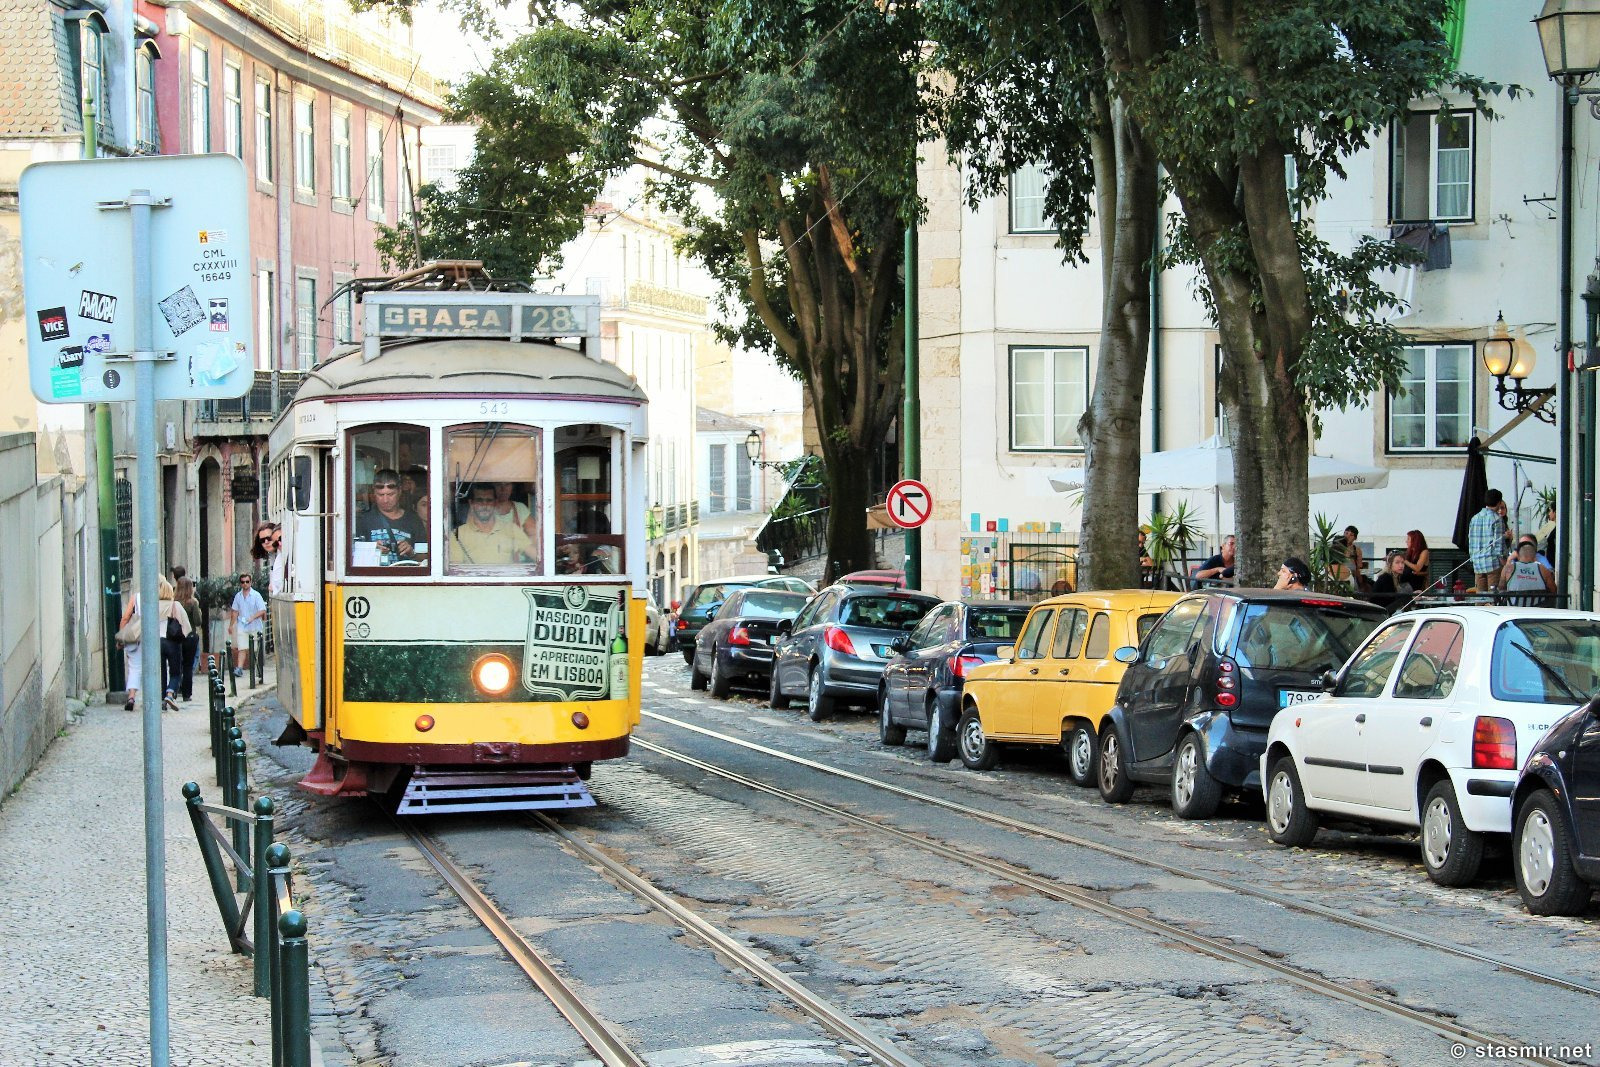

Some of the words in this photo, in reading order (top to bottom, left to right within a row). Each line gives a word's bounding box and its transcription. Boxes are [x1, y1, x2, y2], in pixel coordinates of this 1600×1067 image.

[203, 249, 226, 259] CML
[193, 260, 237, 272] CXXXVIII
[384, 307, 502, 328] GRAÇA
[531, 306, 571, 332] 28
[43, 321, 65, 333] VICE
[480, 401, 508, 414] 543
[536, 610, 590, 626] NASCIDO
[594, 616, 607, 628] EM
[534, 624, 607, 646] DUBLIN
[540, 651, 599, 666] APRECIADO
[530, 663, 549, 679] EM
[554, 666, 603, 684] LISBOA
